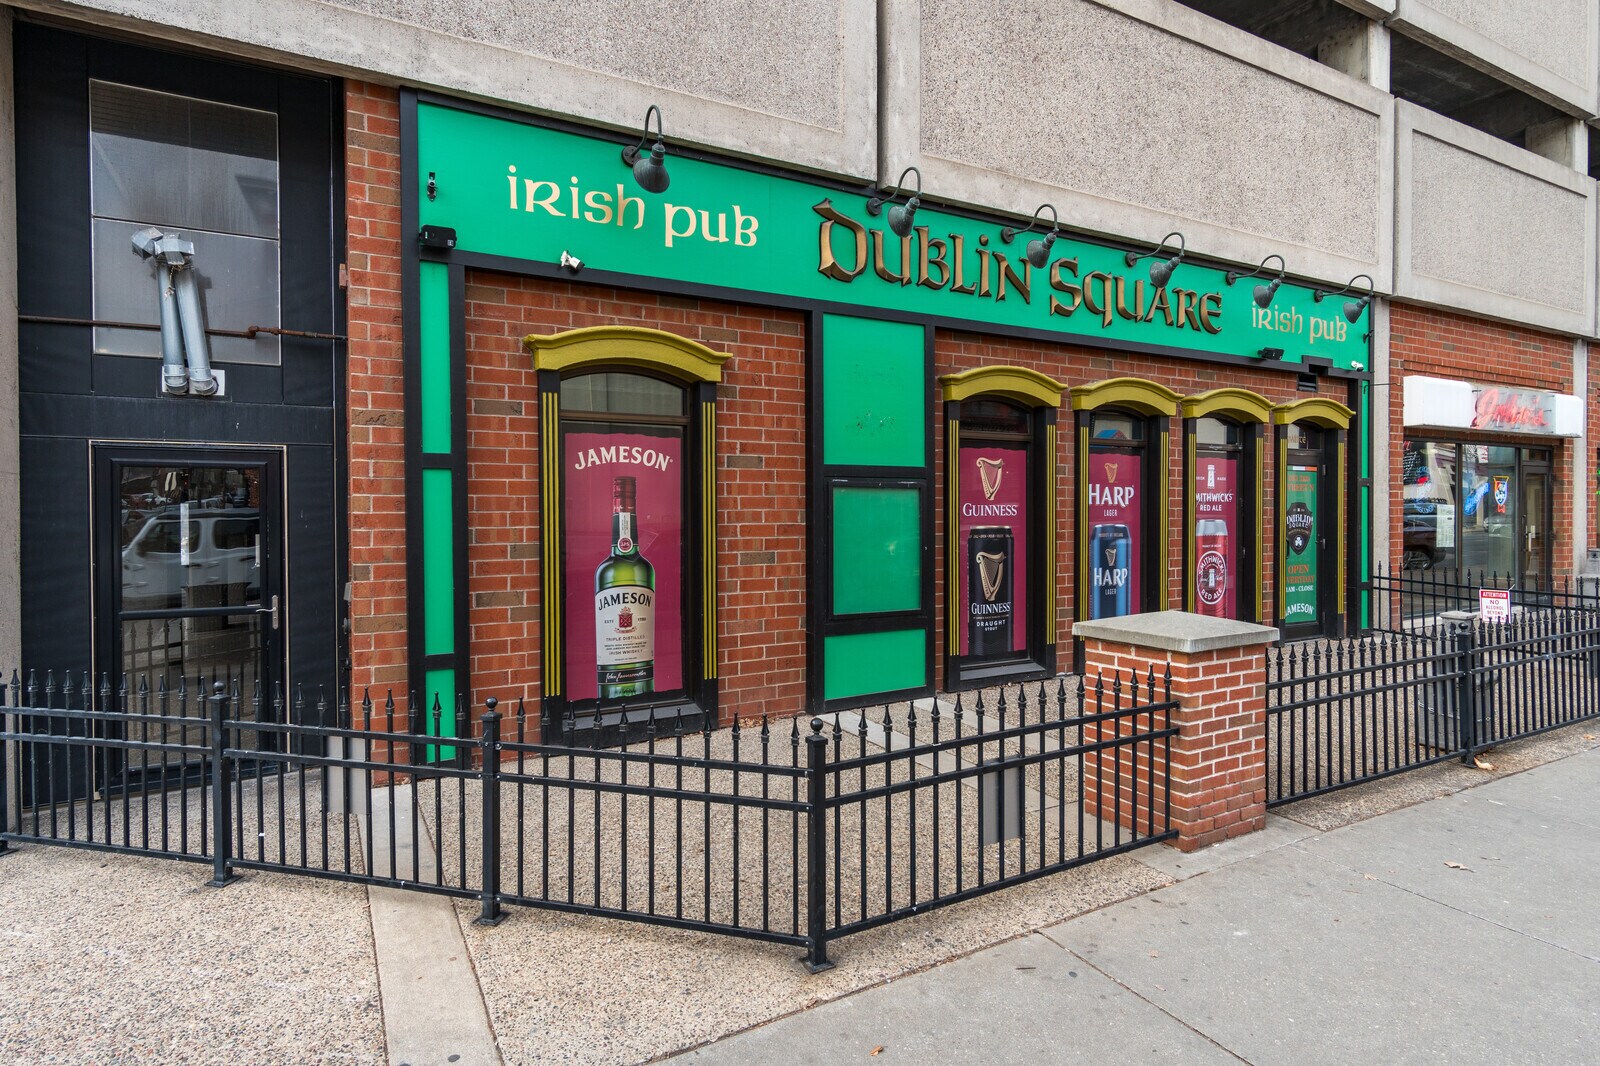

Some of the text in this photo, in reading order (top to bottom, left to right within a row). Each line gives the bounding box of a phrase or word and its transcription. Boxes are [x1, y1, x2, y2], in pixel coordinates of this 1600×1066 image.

[1049, 256, 1223, 335] SQUARE
[575, 446, 670, 471] JAMESON
[1088, 484, 1134, 507] HARP
[962, 503, 1018, 516] GUINNESS
[1104, 509, 1118, 517] LAGER
[1287, 564, 1309, 574] OPEN
[1093, 568, 1128, 588] HARP
[1286, 575, 1314, 584] VERYDAY
[1104, 588, 1117, 596] LAGER
[1201, 588, 1213, 600] RED
[598, 592, 652, 611] JAMESON
[971, 602, 1011, 614] GUINNESS
